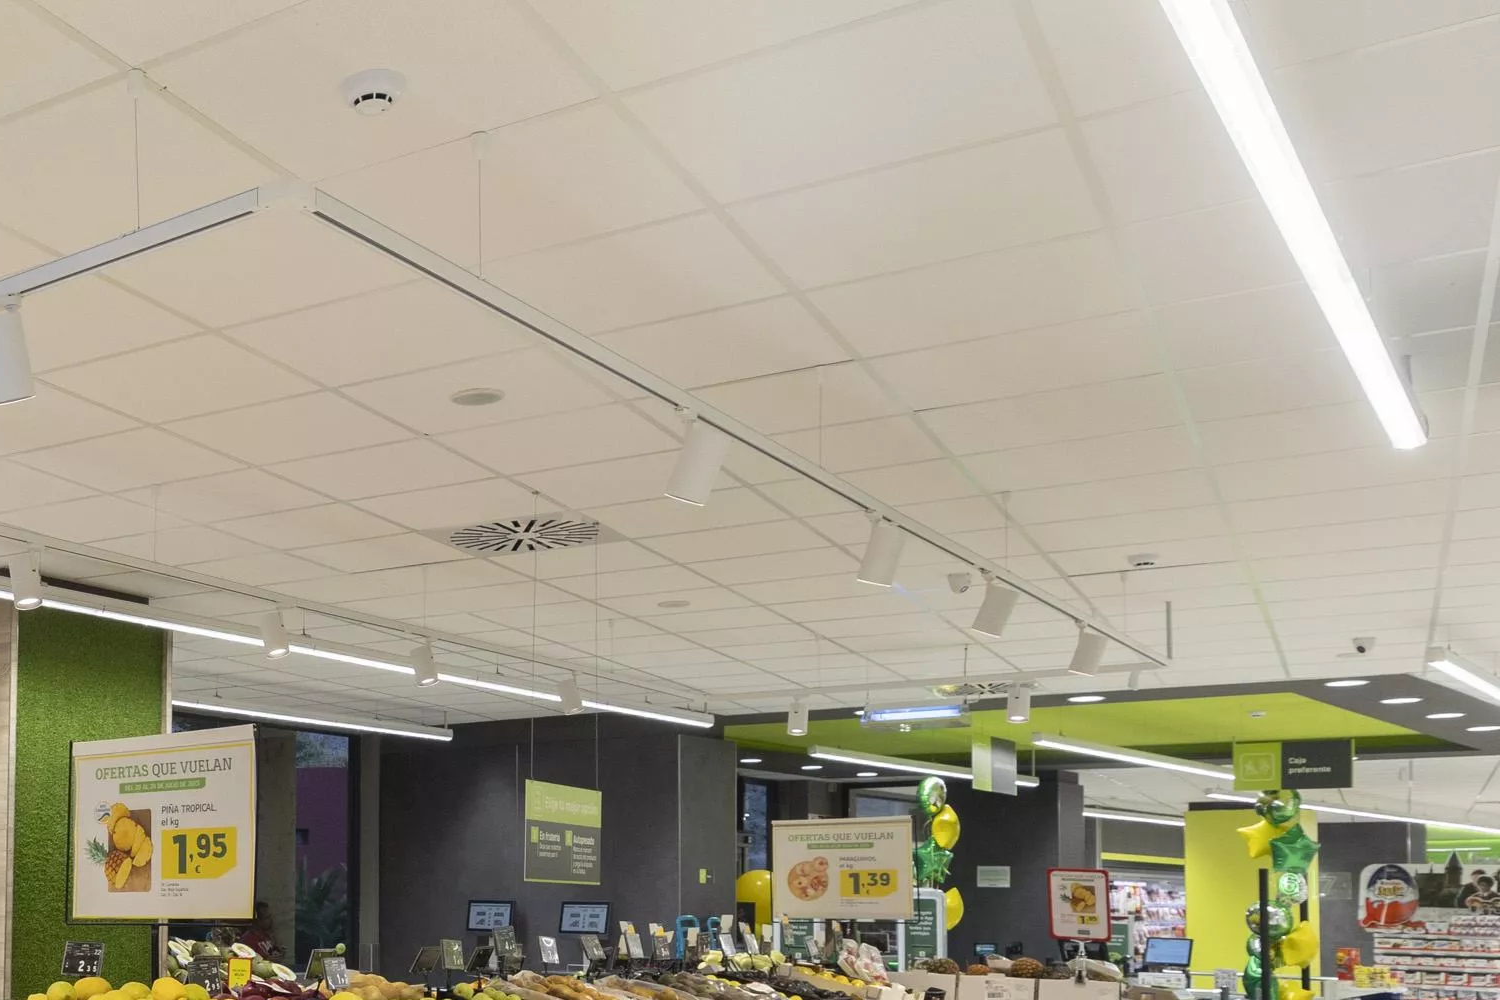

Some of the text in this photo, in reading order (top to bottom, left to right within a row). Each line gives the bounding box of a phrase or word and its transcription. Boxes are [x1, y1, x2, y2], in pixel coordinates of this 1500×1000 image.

[95, 757, 232, 780] OFERTAS QUE VUELAN
[161, 803, 180, 814] PIÑA
[161, 818, 180, 828] el kg
[788, 832, 894, 842] OFERTAS QUE VUELAN
[172, 833, 228, 874] 1,95
[195, 865, 201, 874] €
[848, 872, 891, 895] 1,39
